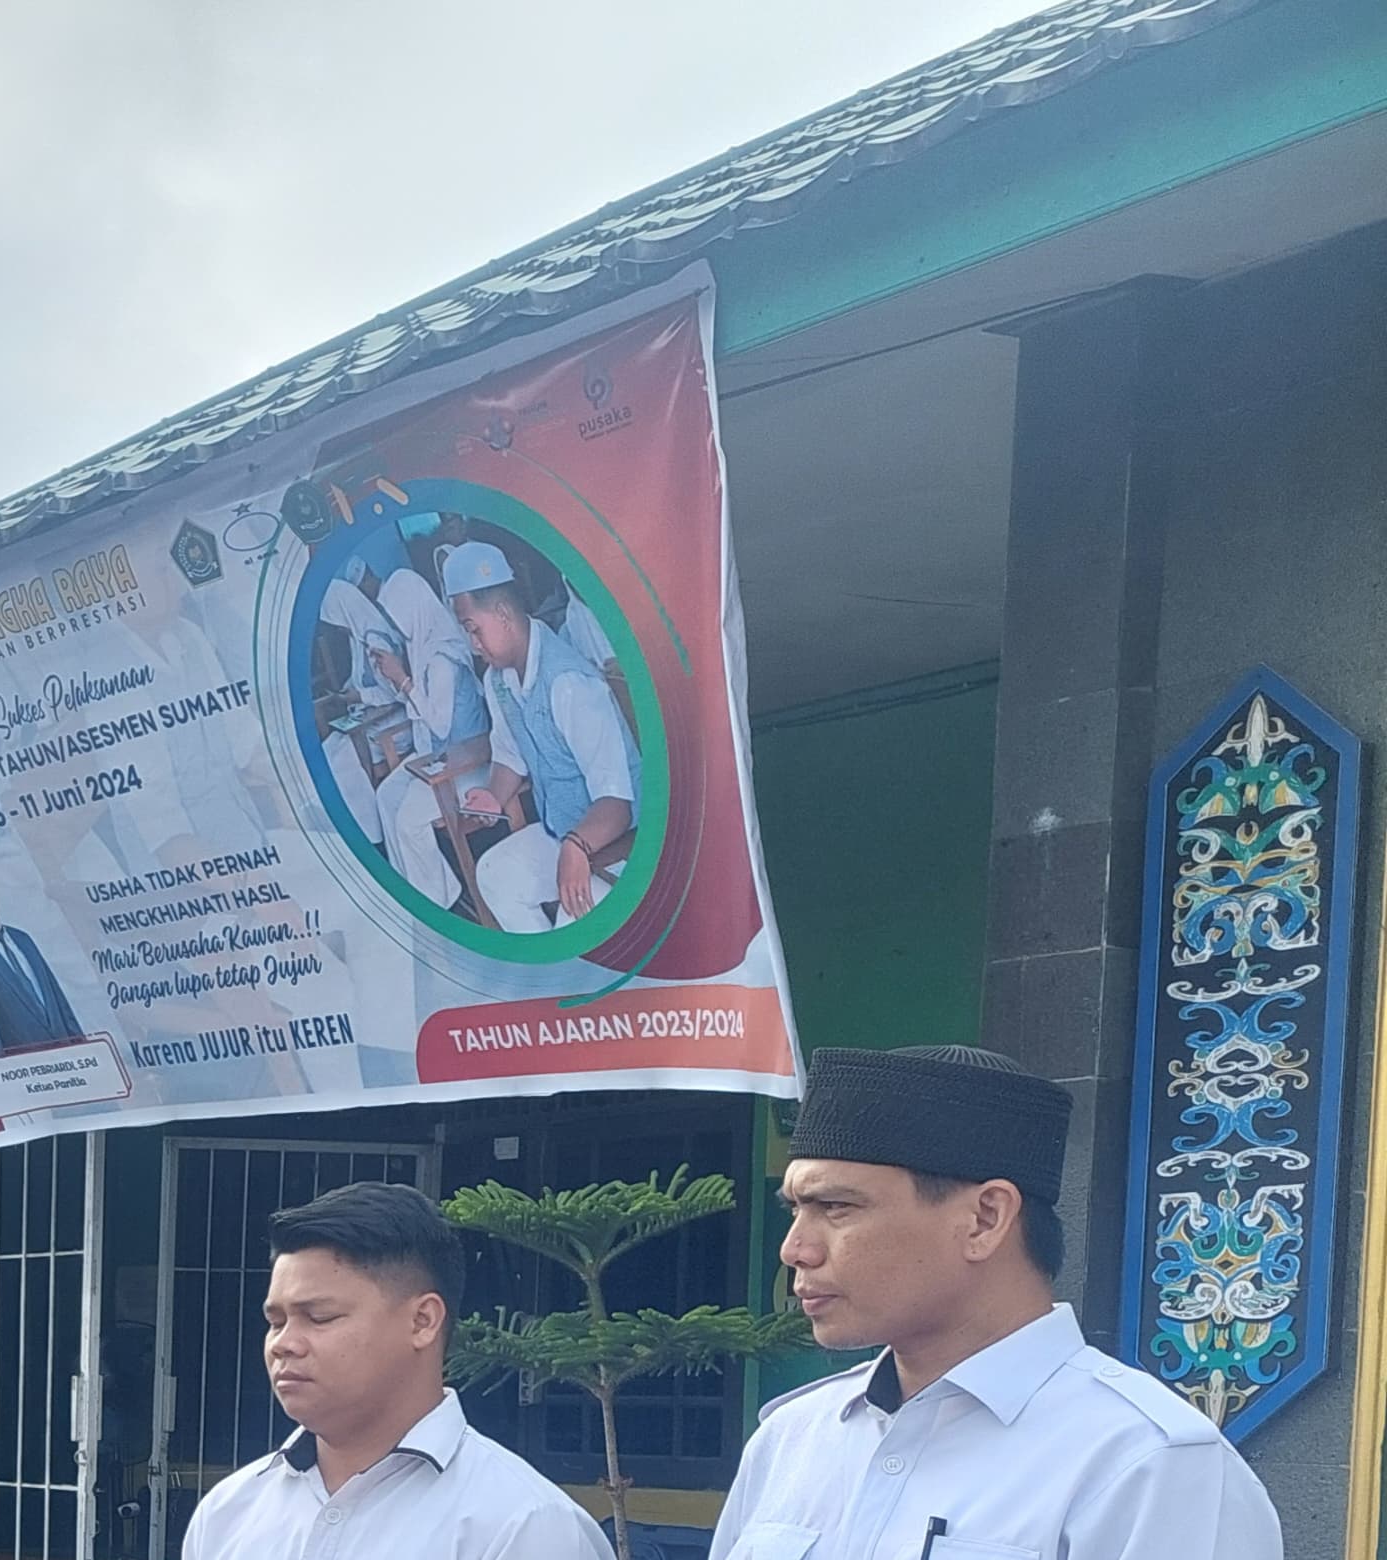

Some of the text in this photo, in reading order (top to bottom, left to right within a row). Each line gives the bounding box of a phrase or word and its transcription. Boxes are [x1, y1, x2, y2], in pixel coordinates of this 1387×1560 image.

[578, 406, 632, 439] pusaka
[51, 543, 139, 614] RAYA
[25, 591, 148, 650] BERPRESTASI
[42, 664, 155, 722] Pelaksanaan
[158, 679, 252, 729] SUMATIF
[19, 793, 41, 819] 11
[42, 778, 86, 814] Juni
[85, 763, 143, 801] 2024
[85, 845, 282, 904] USAHA TIDAK PERNAH
[99, 881, 291, 935] MENGKHIANATI HASIL
[92, 944, 139, 973] Mari
[137, 930, 225, 966] Berusaha
[107, 951, 323, 1009] Jangan lupa tetap Jujur
[129, 1013, 355, 1069] Karena JUJUR itu KEREN
[448, 1008, 745, 1054] TAHUN AJARAN 2023/2024
[0, 1069, 30, 1082] NOOR
[77, 1056, 99, 1070] S.Pd
[25, 1076, 87, 1094] Ketua Panitia
